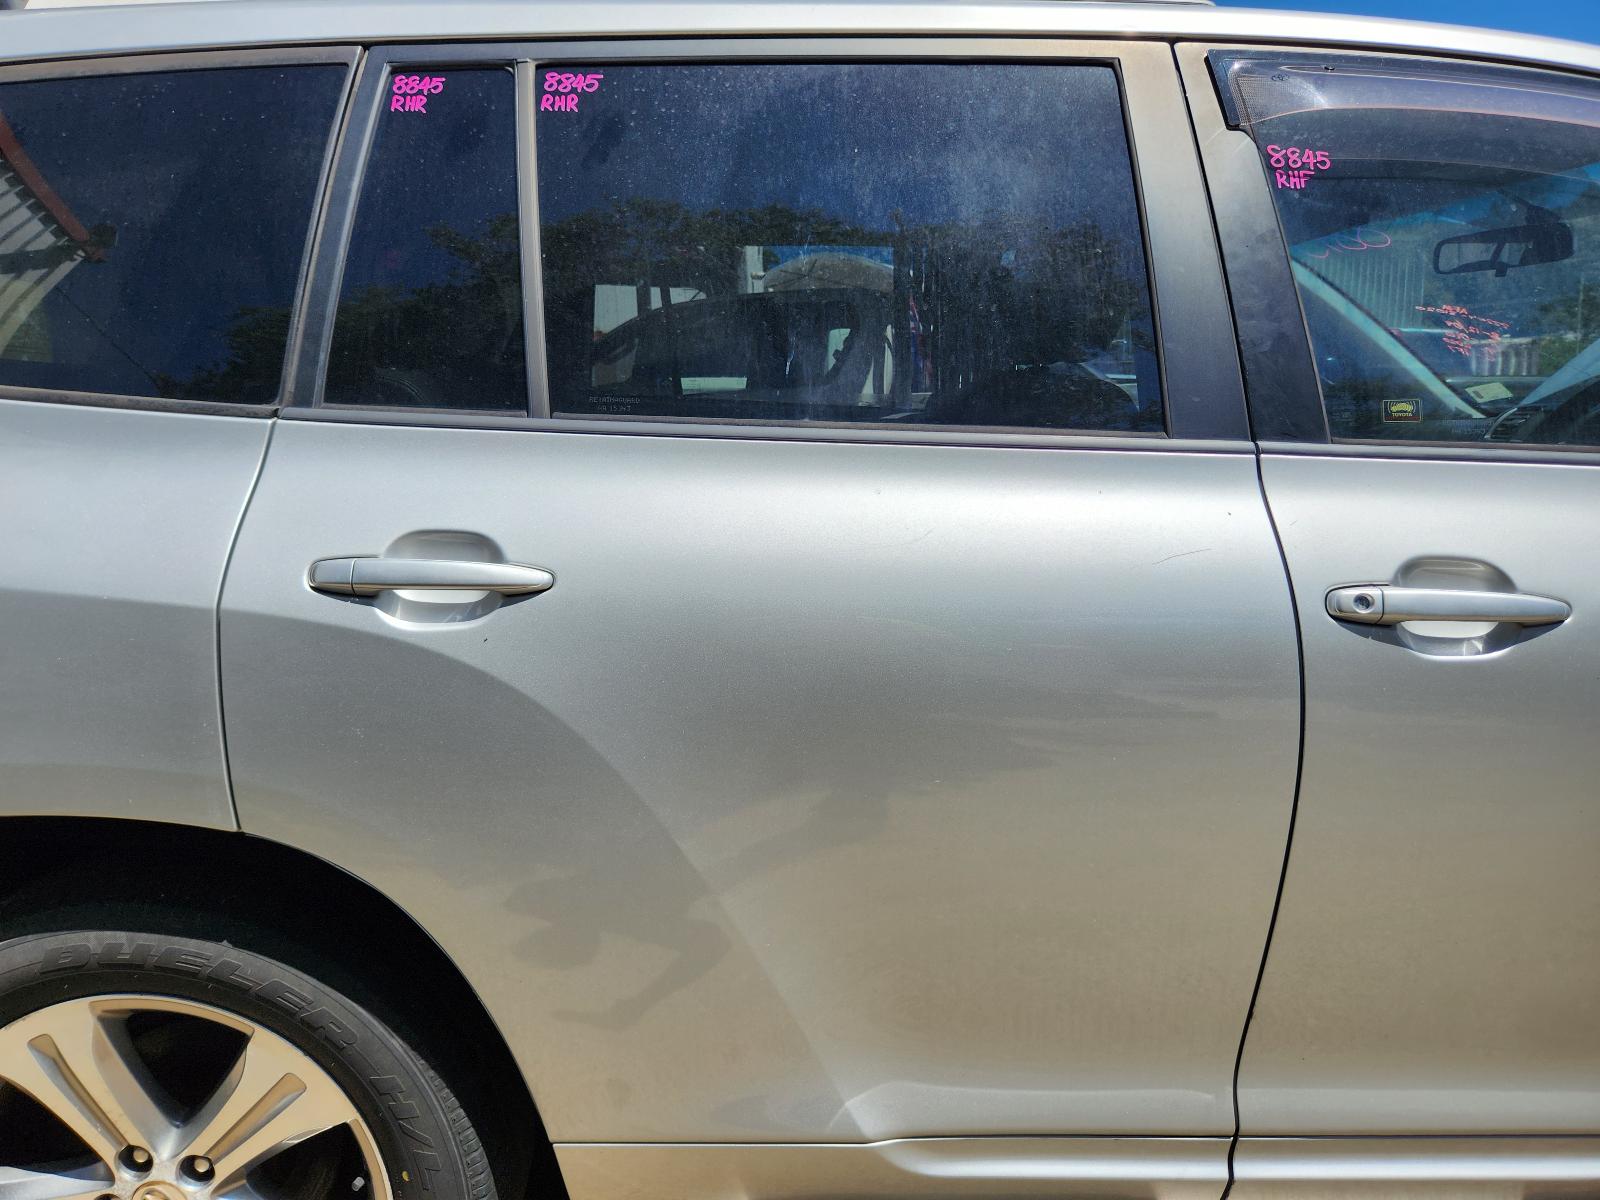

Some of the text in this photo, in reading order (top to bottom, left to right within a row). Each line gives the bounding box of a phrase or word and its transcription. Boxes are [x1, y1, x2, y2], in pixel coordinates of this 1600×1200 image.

[392, 74, 446, 95] 8845
[544, 71, 604, 93] 8845
[390, 94, 427, 114] RHR
[541, 93, 579, 112] RHR
[1266, 144, 1331, 170] 8845
[1275, 169, 1315, 189] RHF
[40, 942, 442, 1191] DUELER H/L
